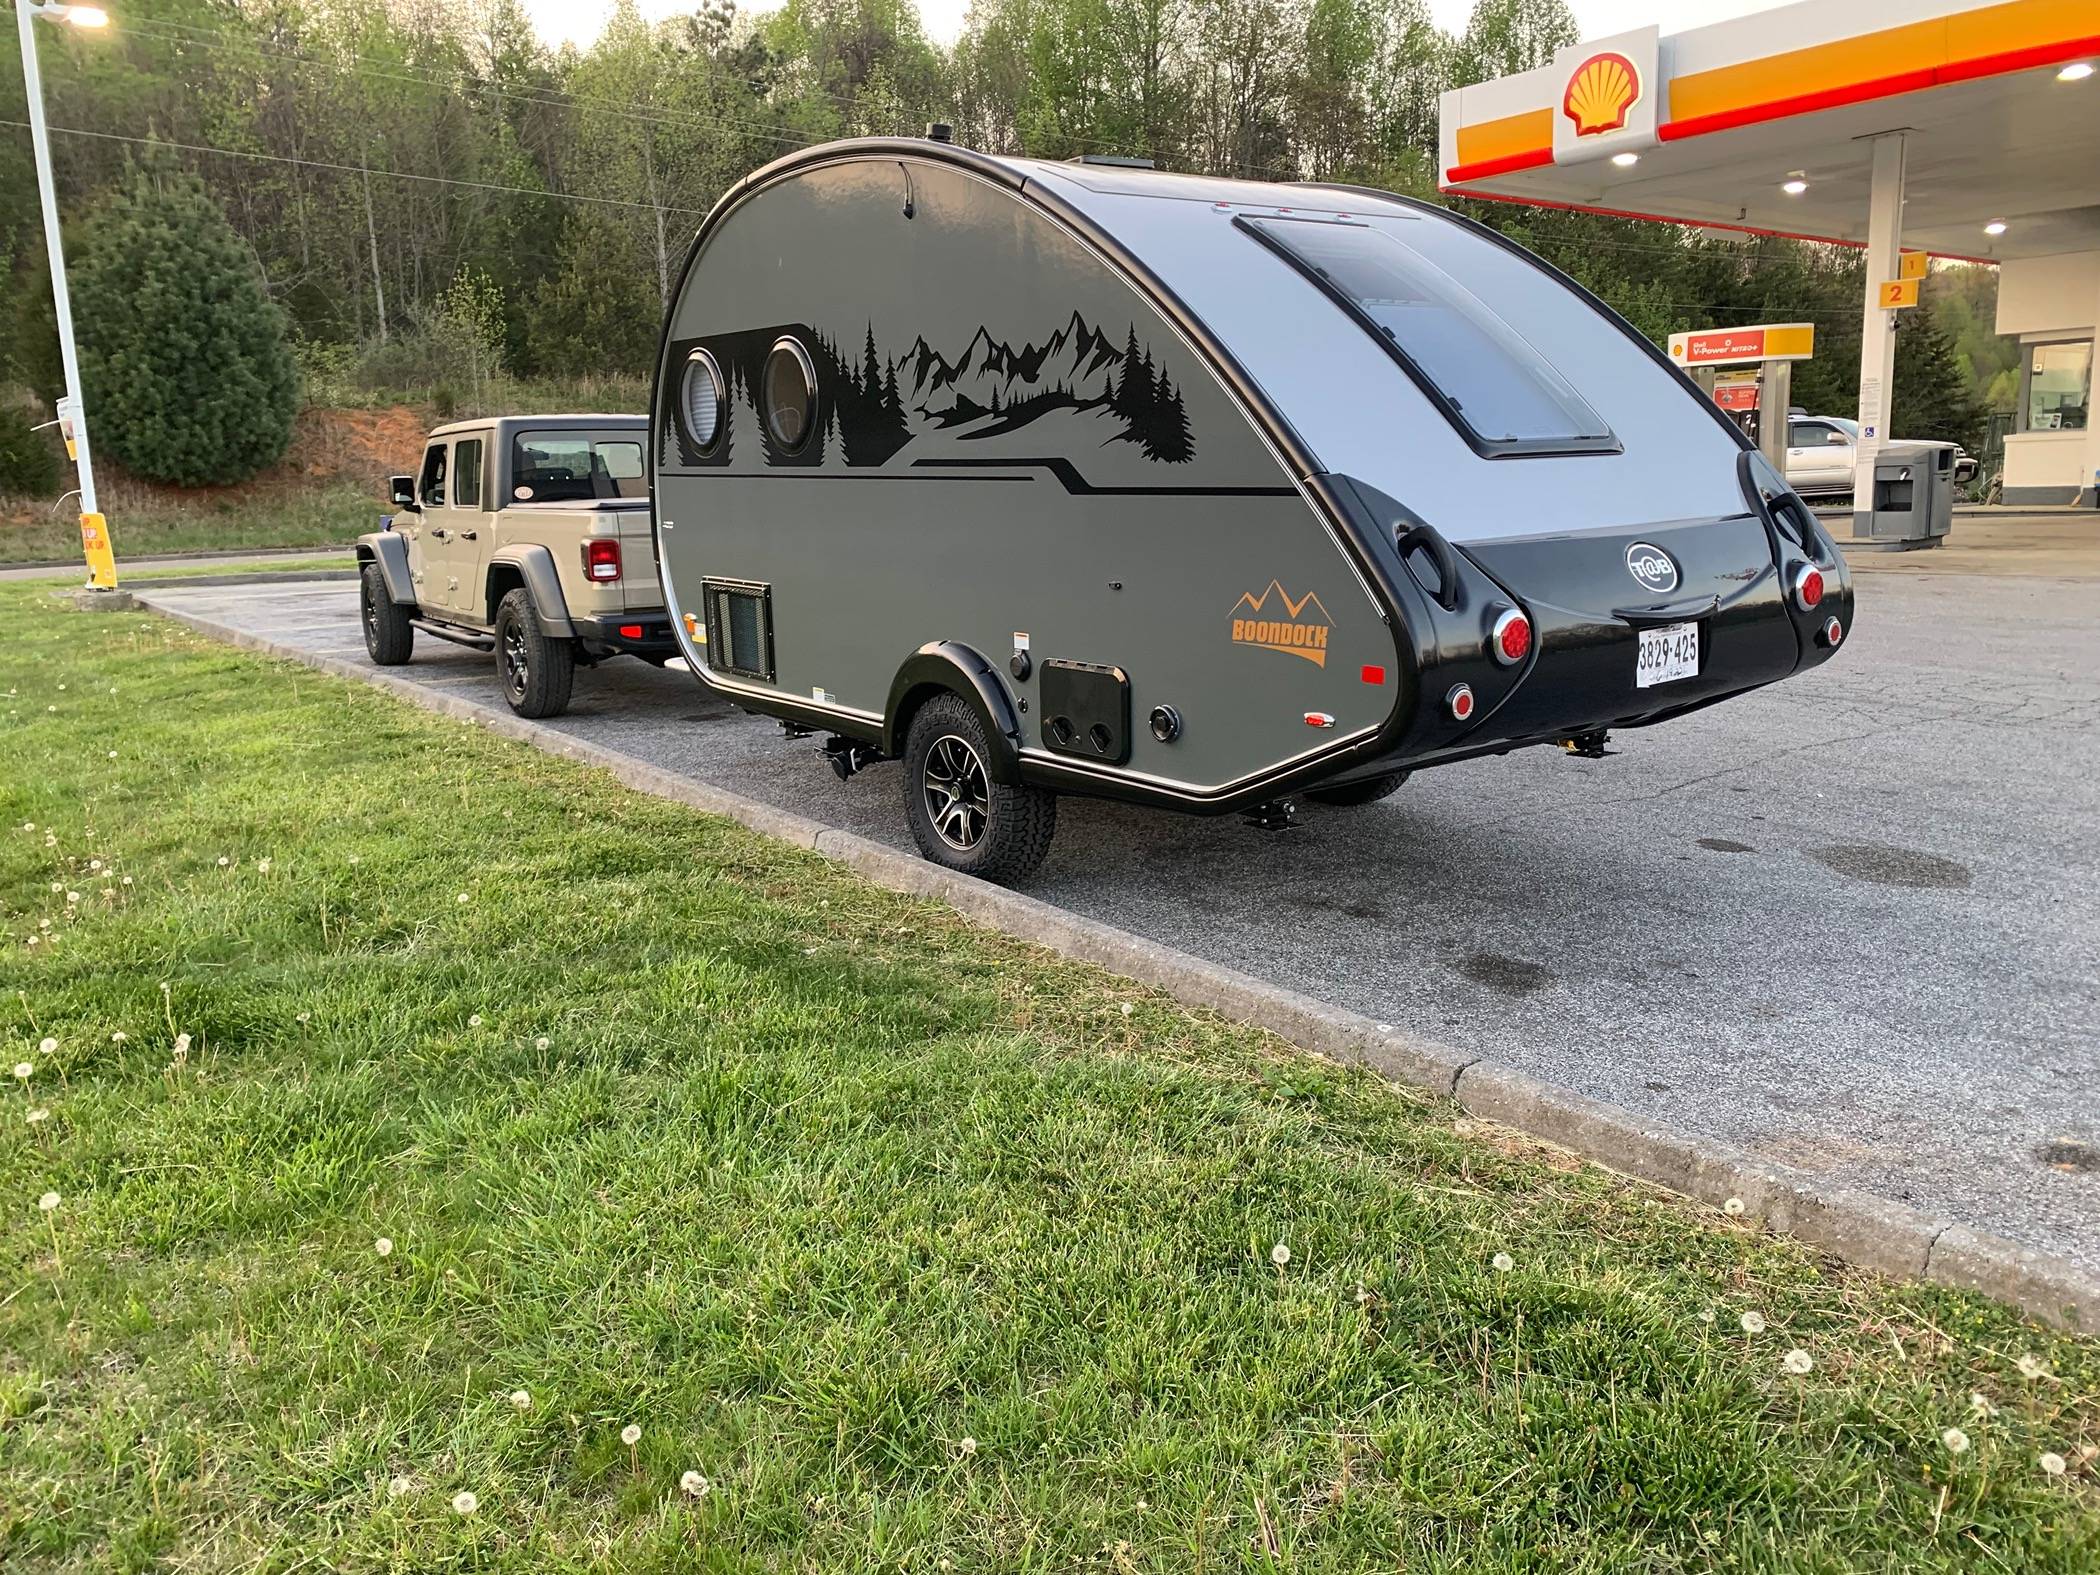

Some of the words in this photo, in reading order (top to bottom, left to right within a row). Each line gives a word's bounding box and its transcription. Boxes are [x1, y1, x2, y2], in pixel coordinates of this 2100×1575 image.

[1909, 260, 1914, 270] 1
[1889, 285, 1902, 302] 2
[1693, 347, 1729, 355] V-Power
[1630, 556, 1673, 582] T@B
[1232, 619, 1328, 649] BOONDOCK
